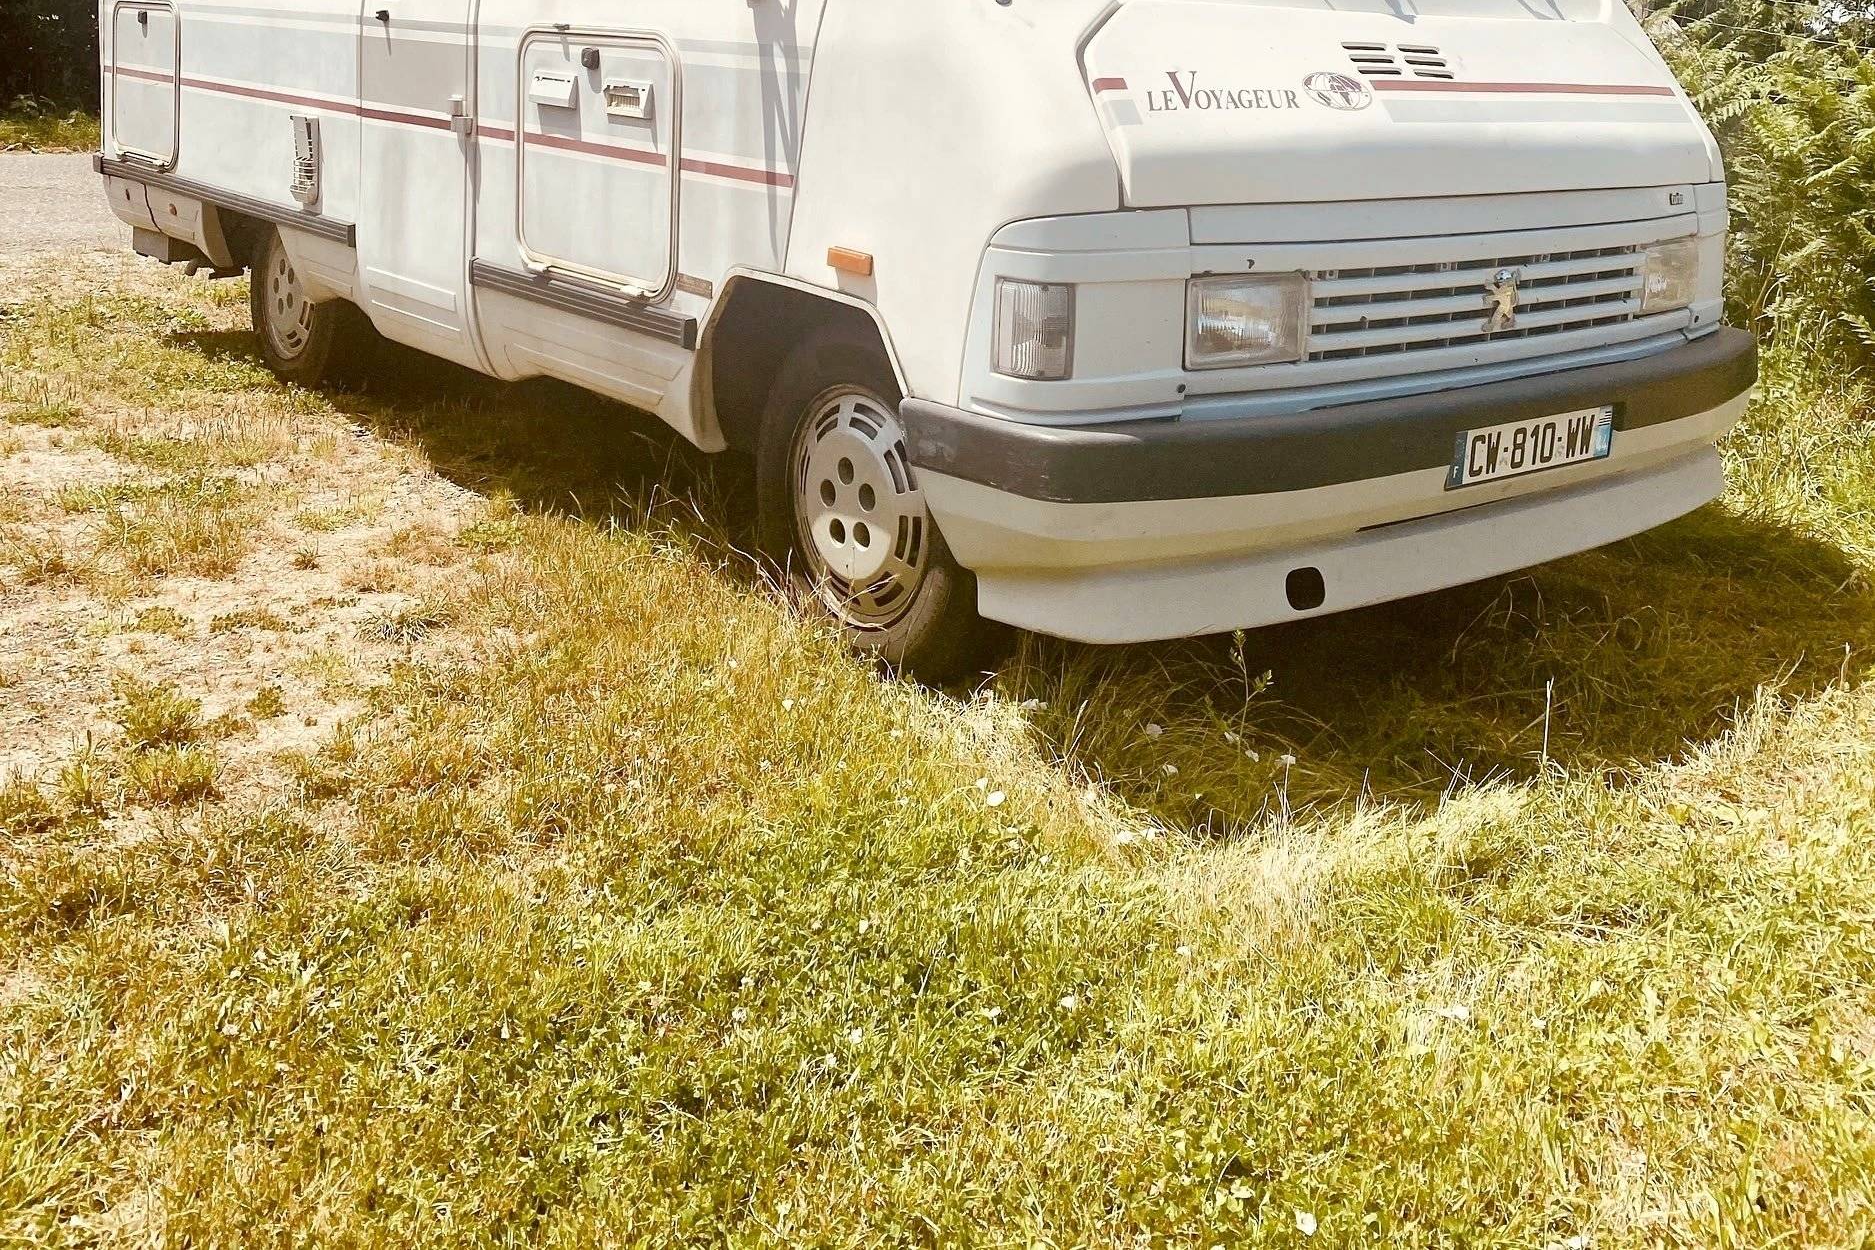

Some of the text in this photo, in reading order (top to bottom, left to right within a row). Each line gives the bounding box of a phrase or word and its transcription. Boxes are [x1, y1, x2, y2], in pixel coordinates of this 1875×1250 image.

[1147, 70, 1300, 111] LE VOYAGEUR
[1452, 466, 1459, 479] F
